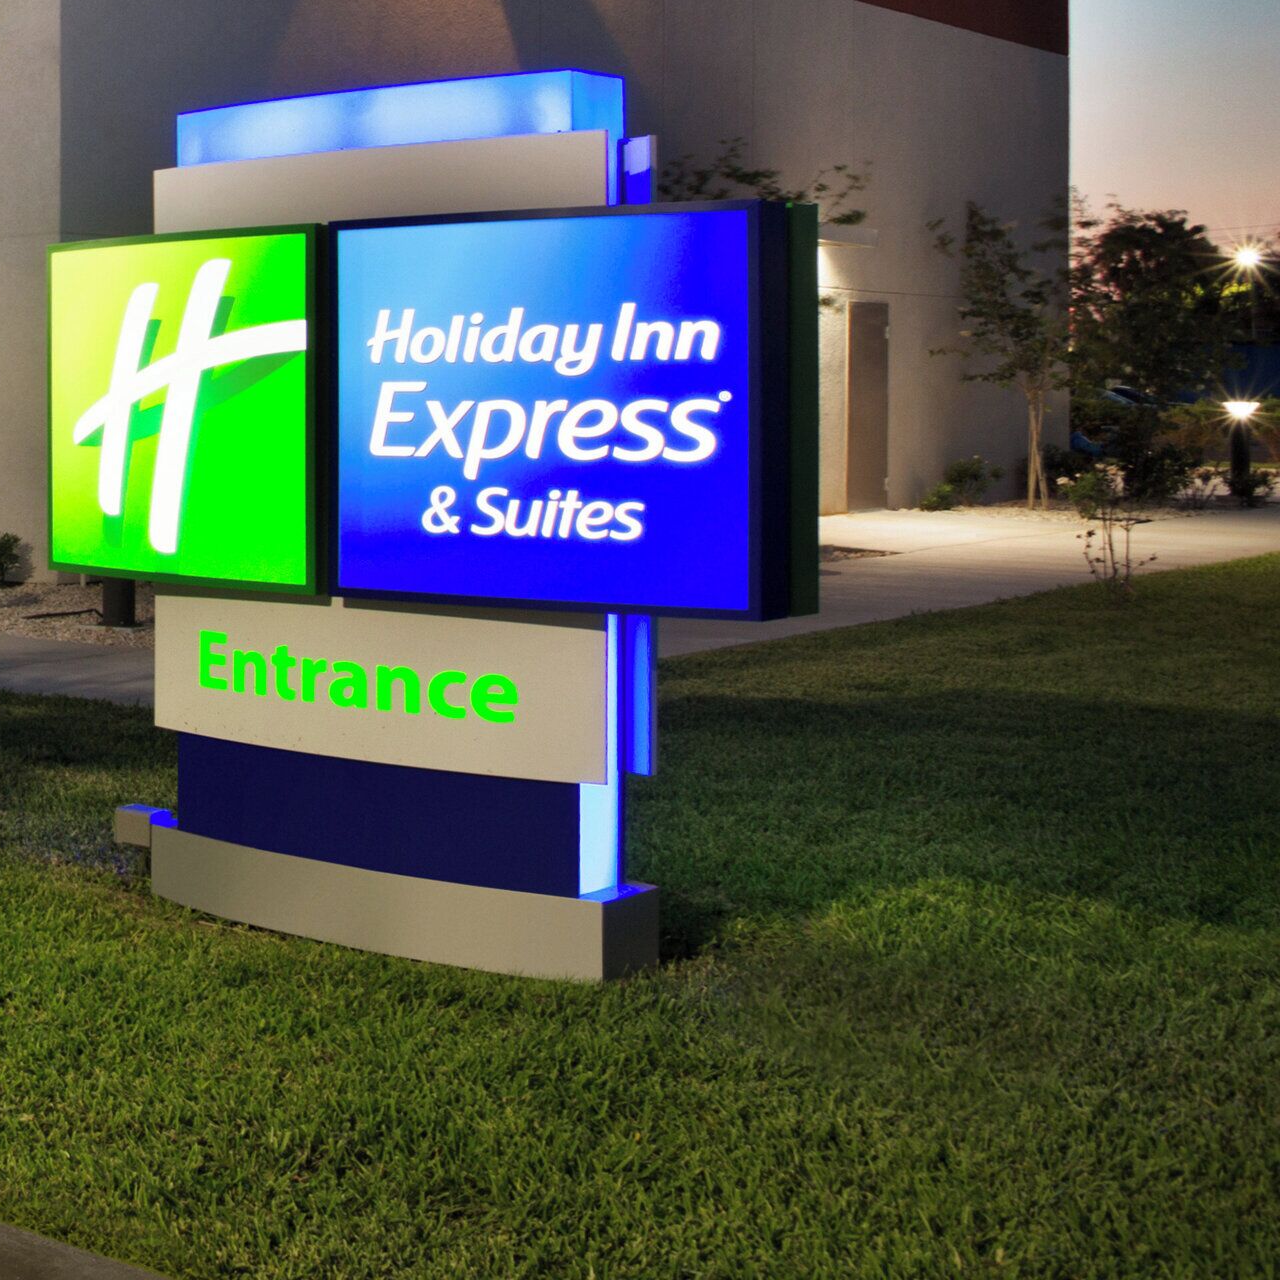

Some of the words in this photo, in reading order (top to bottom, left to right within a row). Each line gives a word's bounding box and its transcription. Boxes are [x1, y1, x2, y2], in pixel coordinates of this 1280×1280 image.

[366, 306, 604, 377] Holiday
[610, 302, 721, 362] Inn
[421, 485, 461, 535] &
[470, 486, 646, 541] Suites
[198, 629, 520, 725] Entrance
